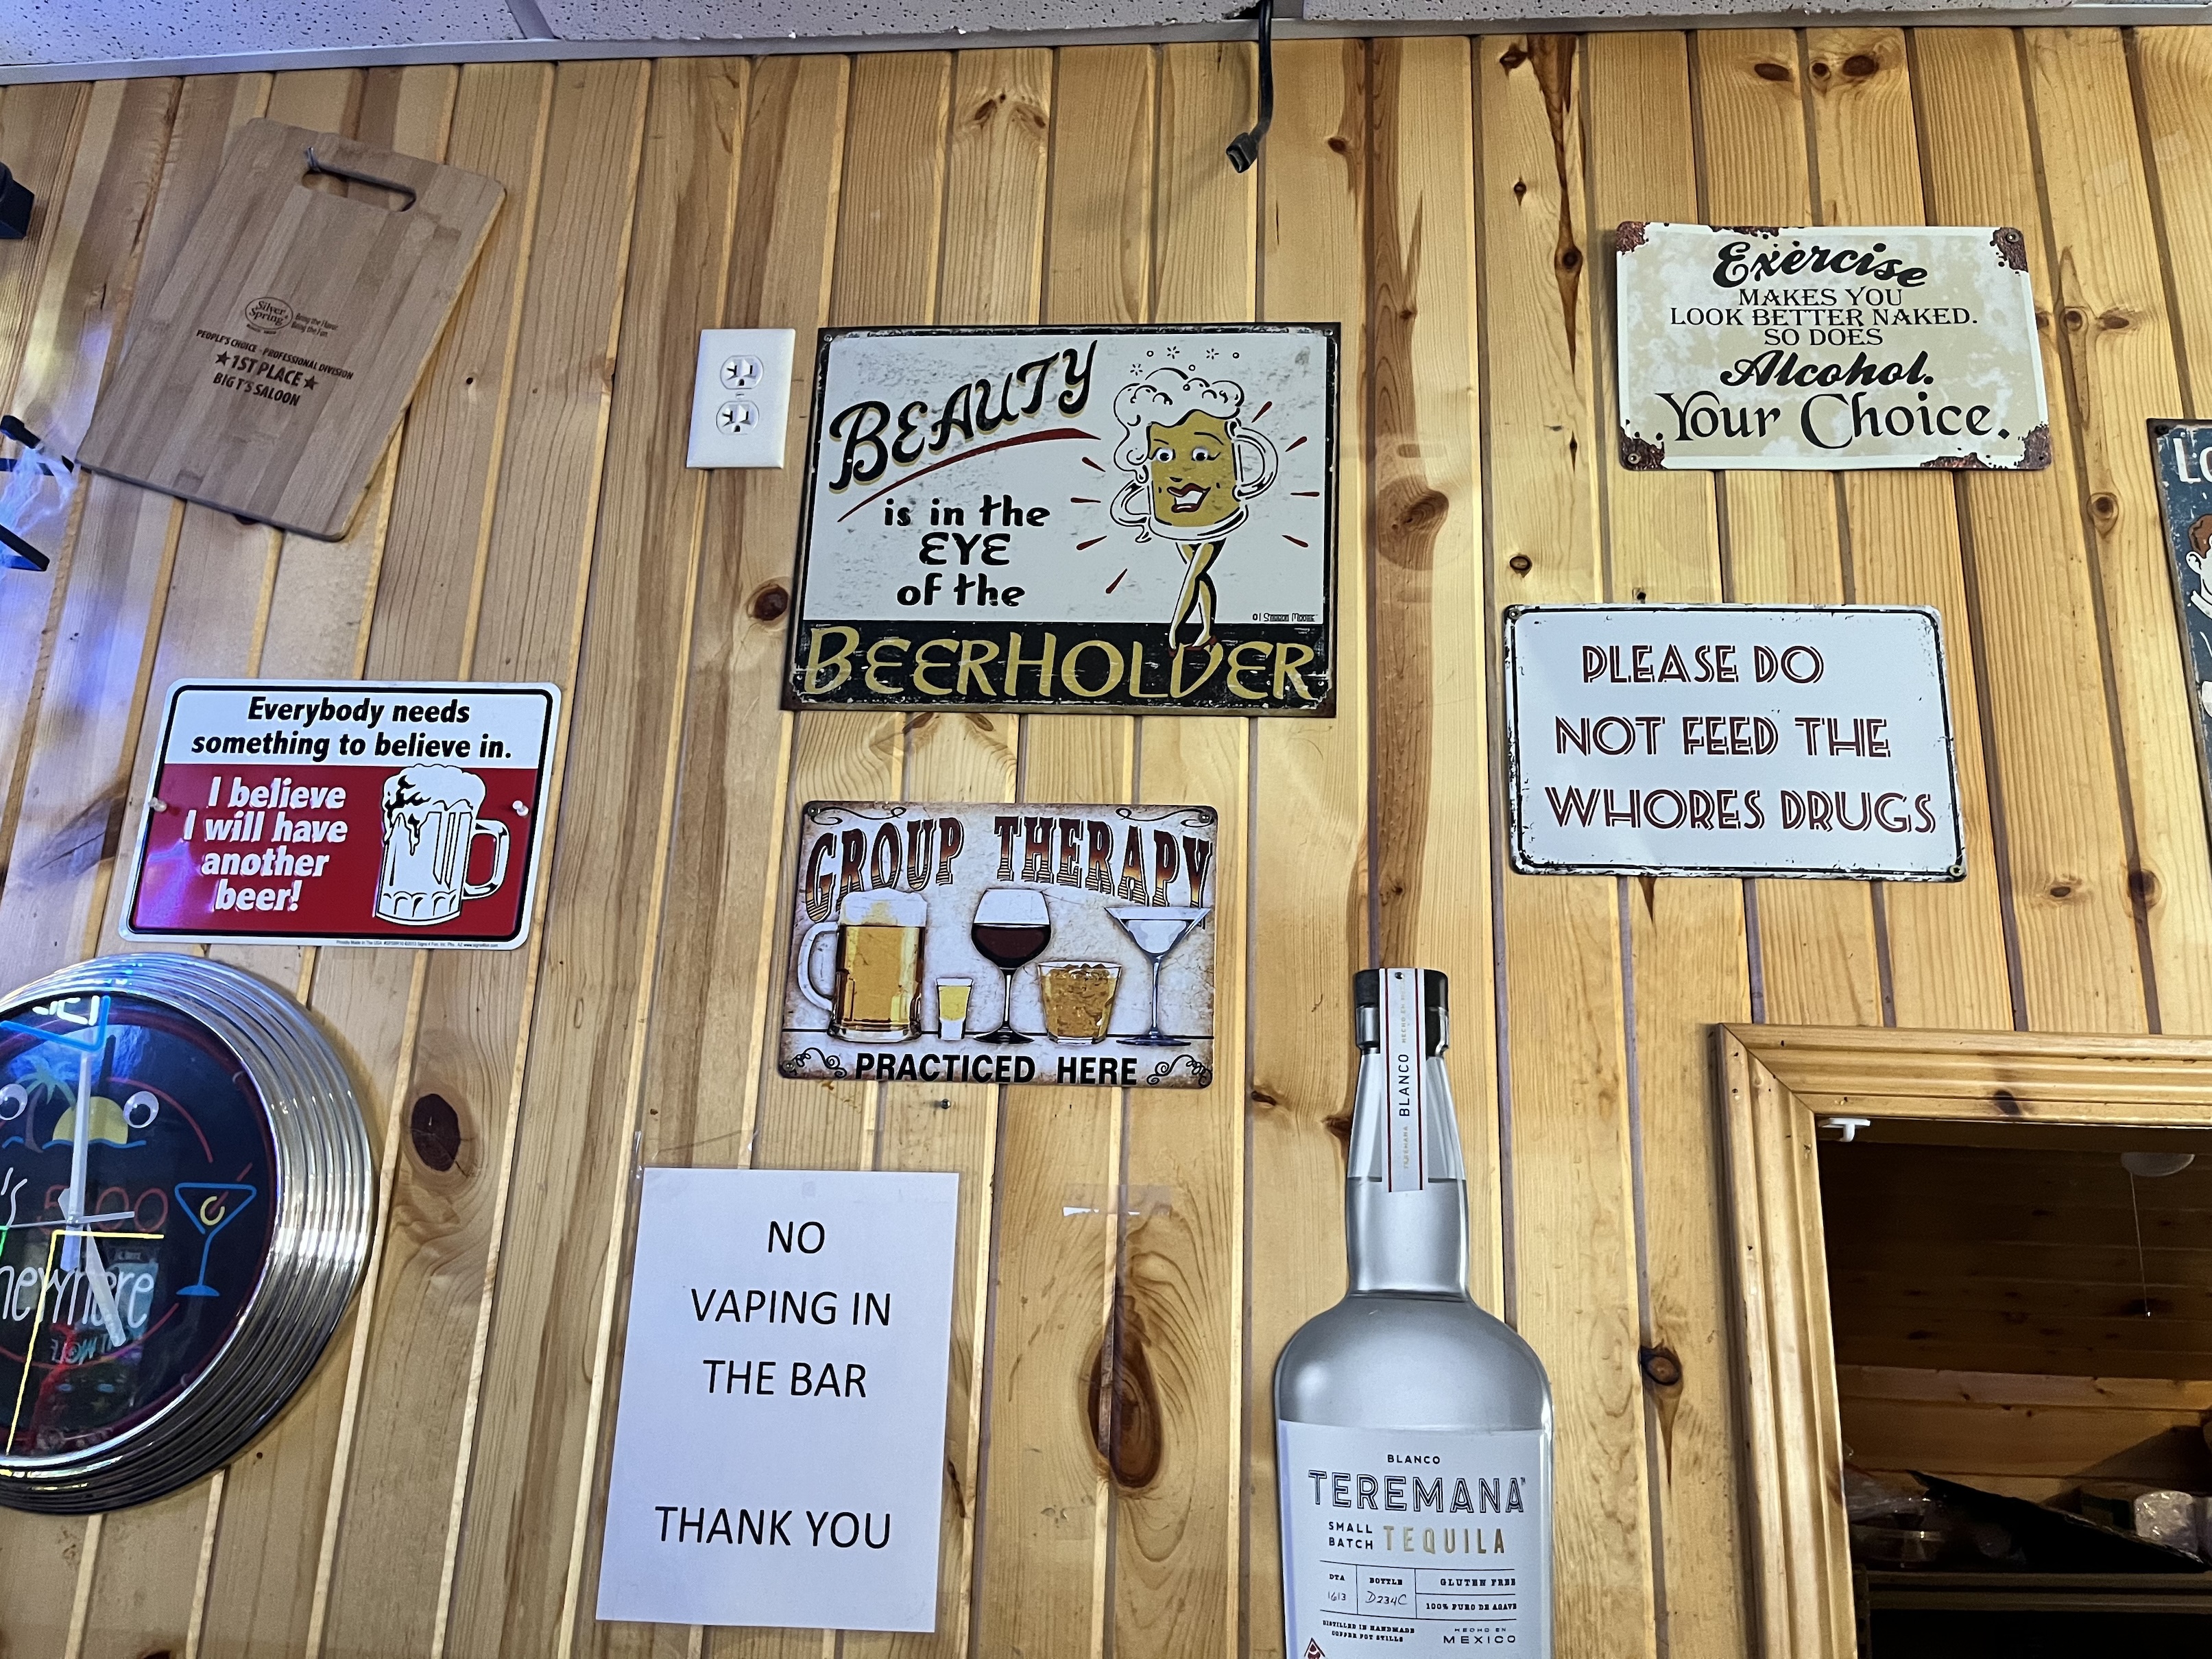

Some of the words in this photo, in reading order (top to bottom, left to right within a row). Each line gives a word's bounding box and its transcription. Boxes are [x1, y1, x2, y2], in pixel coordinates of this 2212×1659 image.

[1712, 241, 1928, 288] Exercise
[256, 300, 286, 315] Silver
[1738, 289, 1837, 307] MAKES
[1846, 285, 1902, 307] YOU
[249, 308, 284, 326] Spring
[1670, 307, 1746, 326] LOOK
[1752, 309, 1864, 326] BETTER
[1873, 308, 1978, 326] NAKED.
[1764, 329, 1800, 346] SO
[1810, 329, 1884, 346] DOES
[196, 329, 231, 346] PEOPLE'S
[230, 338, 258, 353] CHOICE
[262, 348, 317, 370] PROFESSIONAL
[318, 363, 354, 380] DIVISION
[231, 355, 259, 373] 1ST
[257, 361, 304, 386] PLACE
[1720, 350, 1934, 387] Alcohol.
[213, 372, 236, 388] BIG
[236, 378, 254, 393] T'S
[253, 384, 301, 406] SALOON
[828, 339, 1098, 492] BEAUTY
[1655, 390, 1781, 442] Your
[1801, 390, 2010, 450] Choice.
[884, 499, 911, 526] is
[930, 499, 963, 527] in
[978, 494, 1050, 527] the
[919, 533, 1010, 565] EYE
[896, 572, 941, 607] of
[954, 573, 1026, 607] the
[807, 625, 1316, 700] BEERHOLDER
[1581, 645, 1740, 684] PLEASE
[1754, 645, 1825, 684] DO
[248, 695, 385, 728] Everybody
[392, 698, 470, 723] needs
[191, 731, 330, 762] something
[339, 734, 365, 756] to
[375, 734, 471, 758] believe
[480, 734, 512, 759] in.
[1555, 716, 1666, 756] NOT
[1682, 717, 1779, 755] FEED
[1794, 717, 1891, 758] THE
[206, 776, 223, 809] I
[228, 777, 346, 810] believe
[1545, 786, 1766, 831] WHORES
[1781, 790, 1937, 834] DRUGS
[182, 810, 197, 842] I
[204, 811, 263, 843] will
[272, 811, 348, 844] have
[200, 845, 330, 878] another
[806, 817, 965, 922] GROUP
[994, 815, 1214, 929] THERAPY
[215, 880, 302, 912] beer!
[854, 1053, 1036, 1083] PRACTICED
[1057, 1057, 1138, 1085] HERE
[1399, 1053, 1410, 1117] BLANCO
[767, 1221, 825, 1254] NO
[691, 1288, 837, 1325] VAPING
[853, 1293, 891, 1326] IN
[703, 1359, 776, 1396] THE
[791, 1362, 867, 1398] BAR
[1386, 1454, 1441, 1464] BLANCO
[1308, 1469, 1524, 1513] TEREMANA
[655, 1506, 793, 1546] THANK
[806, 1510, 891, 1549] YOU
[1328, 1521, 1373, 1534] SMALL
[1329, 1537, 1373, 1550] BATCH
[1382, 1525, 1505, 1554] TEQUILA
[1369, 1577, 1403, 1586] BOTTLE
[1440, 1578, 1487, 1586] GLUTEN
[1491, 1578, 1516, 1586] FREE
[1323, 1620, 1356, 1630] DISTILLED
[1369, 1625, 1415, 1634] HANDMADE
[1332, 1630, 1357, 1639] COPPER
[1443, 1635, 1516, 1644] MEXICO
